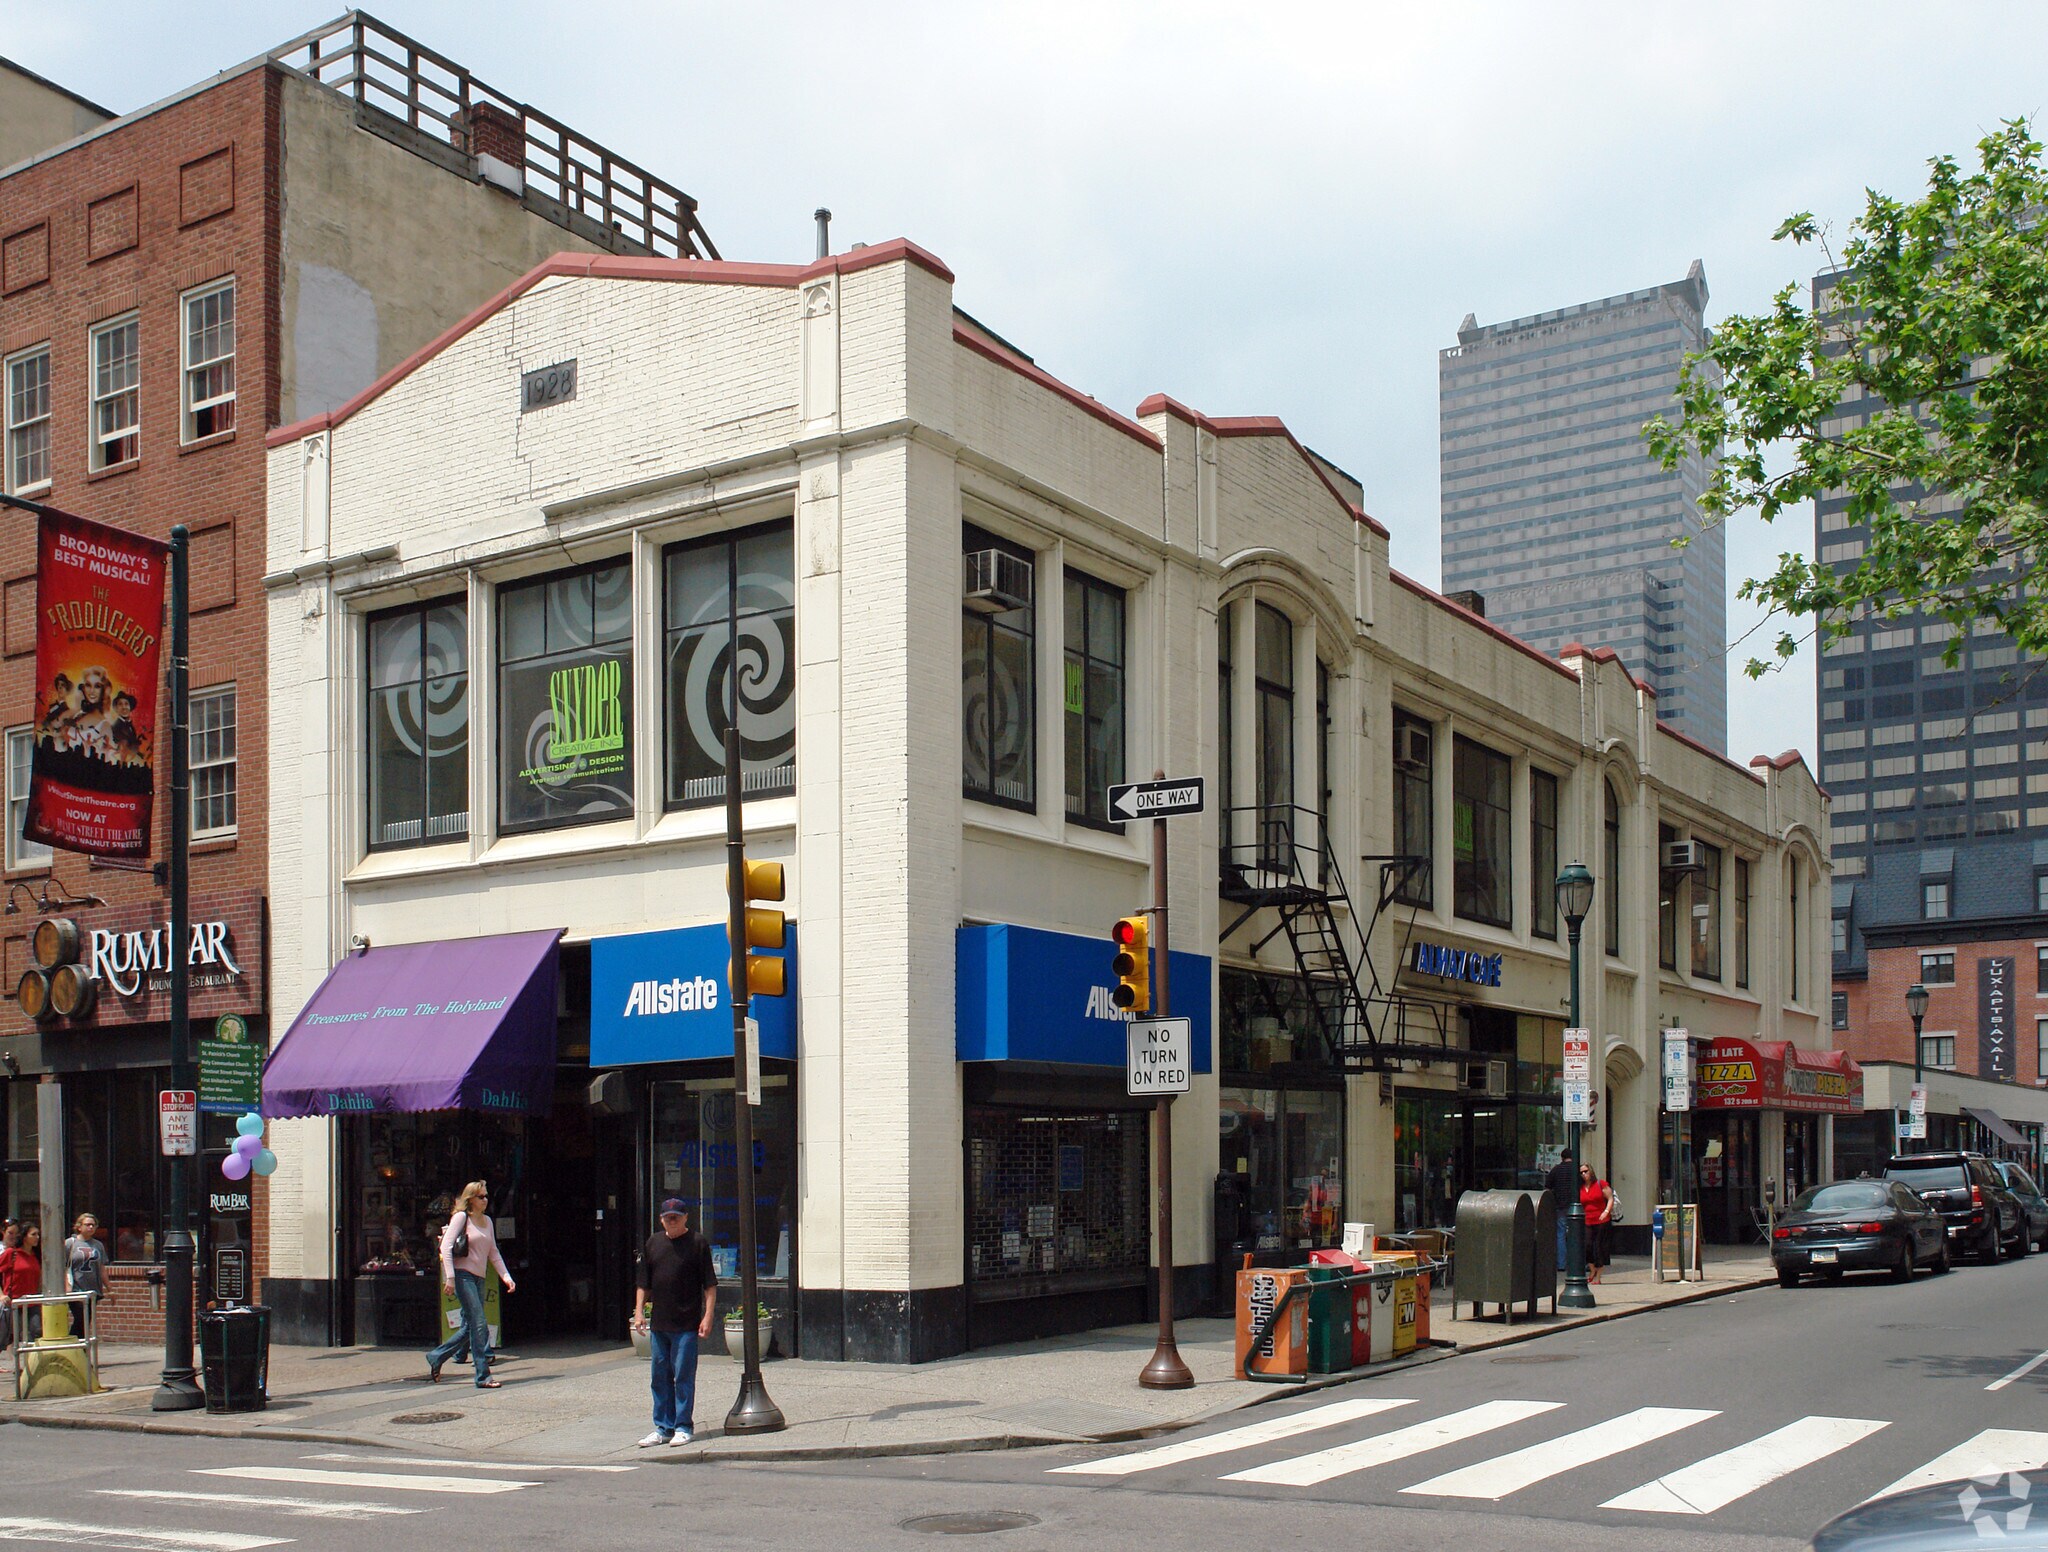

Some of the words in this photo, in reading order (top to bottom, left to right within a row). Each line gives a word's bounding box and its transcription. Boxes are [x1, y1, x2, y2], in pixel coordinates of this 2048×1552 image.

[527, 370, 572, 405] 1928
[60, 534, 148, 569] BROADWAY'S
[54, 549, 85, 569] BEST
[89, 561, 150, 585] MUSICAL!
[93, 586, 110, 602] THE
[519, 762, 577, 777] ADVERTISING
[589, 754, 625, 766] DESIGN
[529, 774, 560, 785] strategic
[563, 765, 624, 780] communications
[1137, 793, 1163, 808] ONE
[1168, 789, 1193, 804] WAY
[66, 808, 91, 822] NOW
[93, 814, 107, 824] AT
[80, 837, 110, 847] WALNUT
[112, 840, 143, 849] STREETS
[107, 829, 143, 841] THEATRE
[90, 929, 162, 996] RUM
[166, 921, 240, 974] AR
[1417, 942, 1468, 980] ALMAZ
[149, 978, 172, 990] LOUN
[623, 975, 718, 1017] Allstate
[305, 1010, 369, 1025] Treasures
[371, 1006, 408, 1019] From
[412, 1003, 439, 1016] The
[443, 997, 508, 1015] Holyland
[1148, 1029, 1170, 1044] NO
[1572, 1042, 1581, 1050] NO
[1141, 1049, 1177, 1064] TURN
[1698, 1048, 1718, 1058] PEN
[1722, 1047, 1744, 1058] LATE
[1134, 1071, 1152, 1085] ON
[1158, 1069, 1185, 1084] RED
[1668, 1078, 1673, 1088] 2
[163, 1103, 194, 1111] STOPPING
[171, 1093, 185, 1103] NO
[328, 1092, 375, 1111] Dahlia
[482, 1088, 529, 1109] Dahlia
[1723, 1097, 1735, 1105] 132
[676, 1139, 766, 1169] Allste
[210, 1194, 231, 1212] RUM
[231, 1193, 250, 1210] BAR
[77, 1247, 100, 1273] P
[1399, 1302, 1415, 1325] PW
